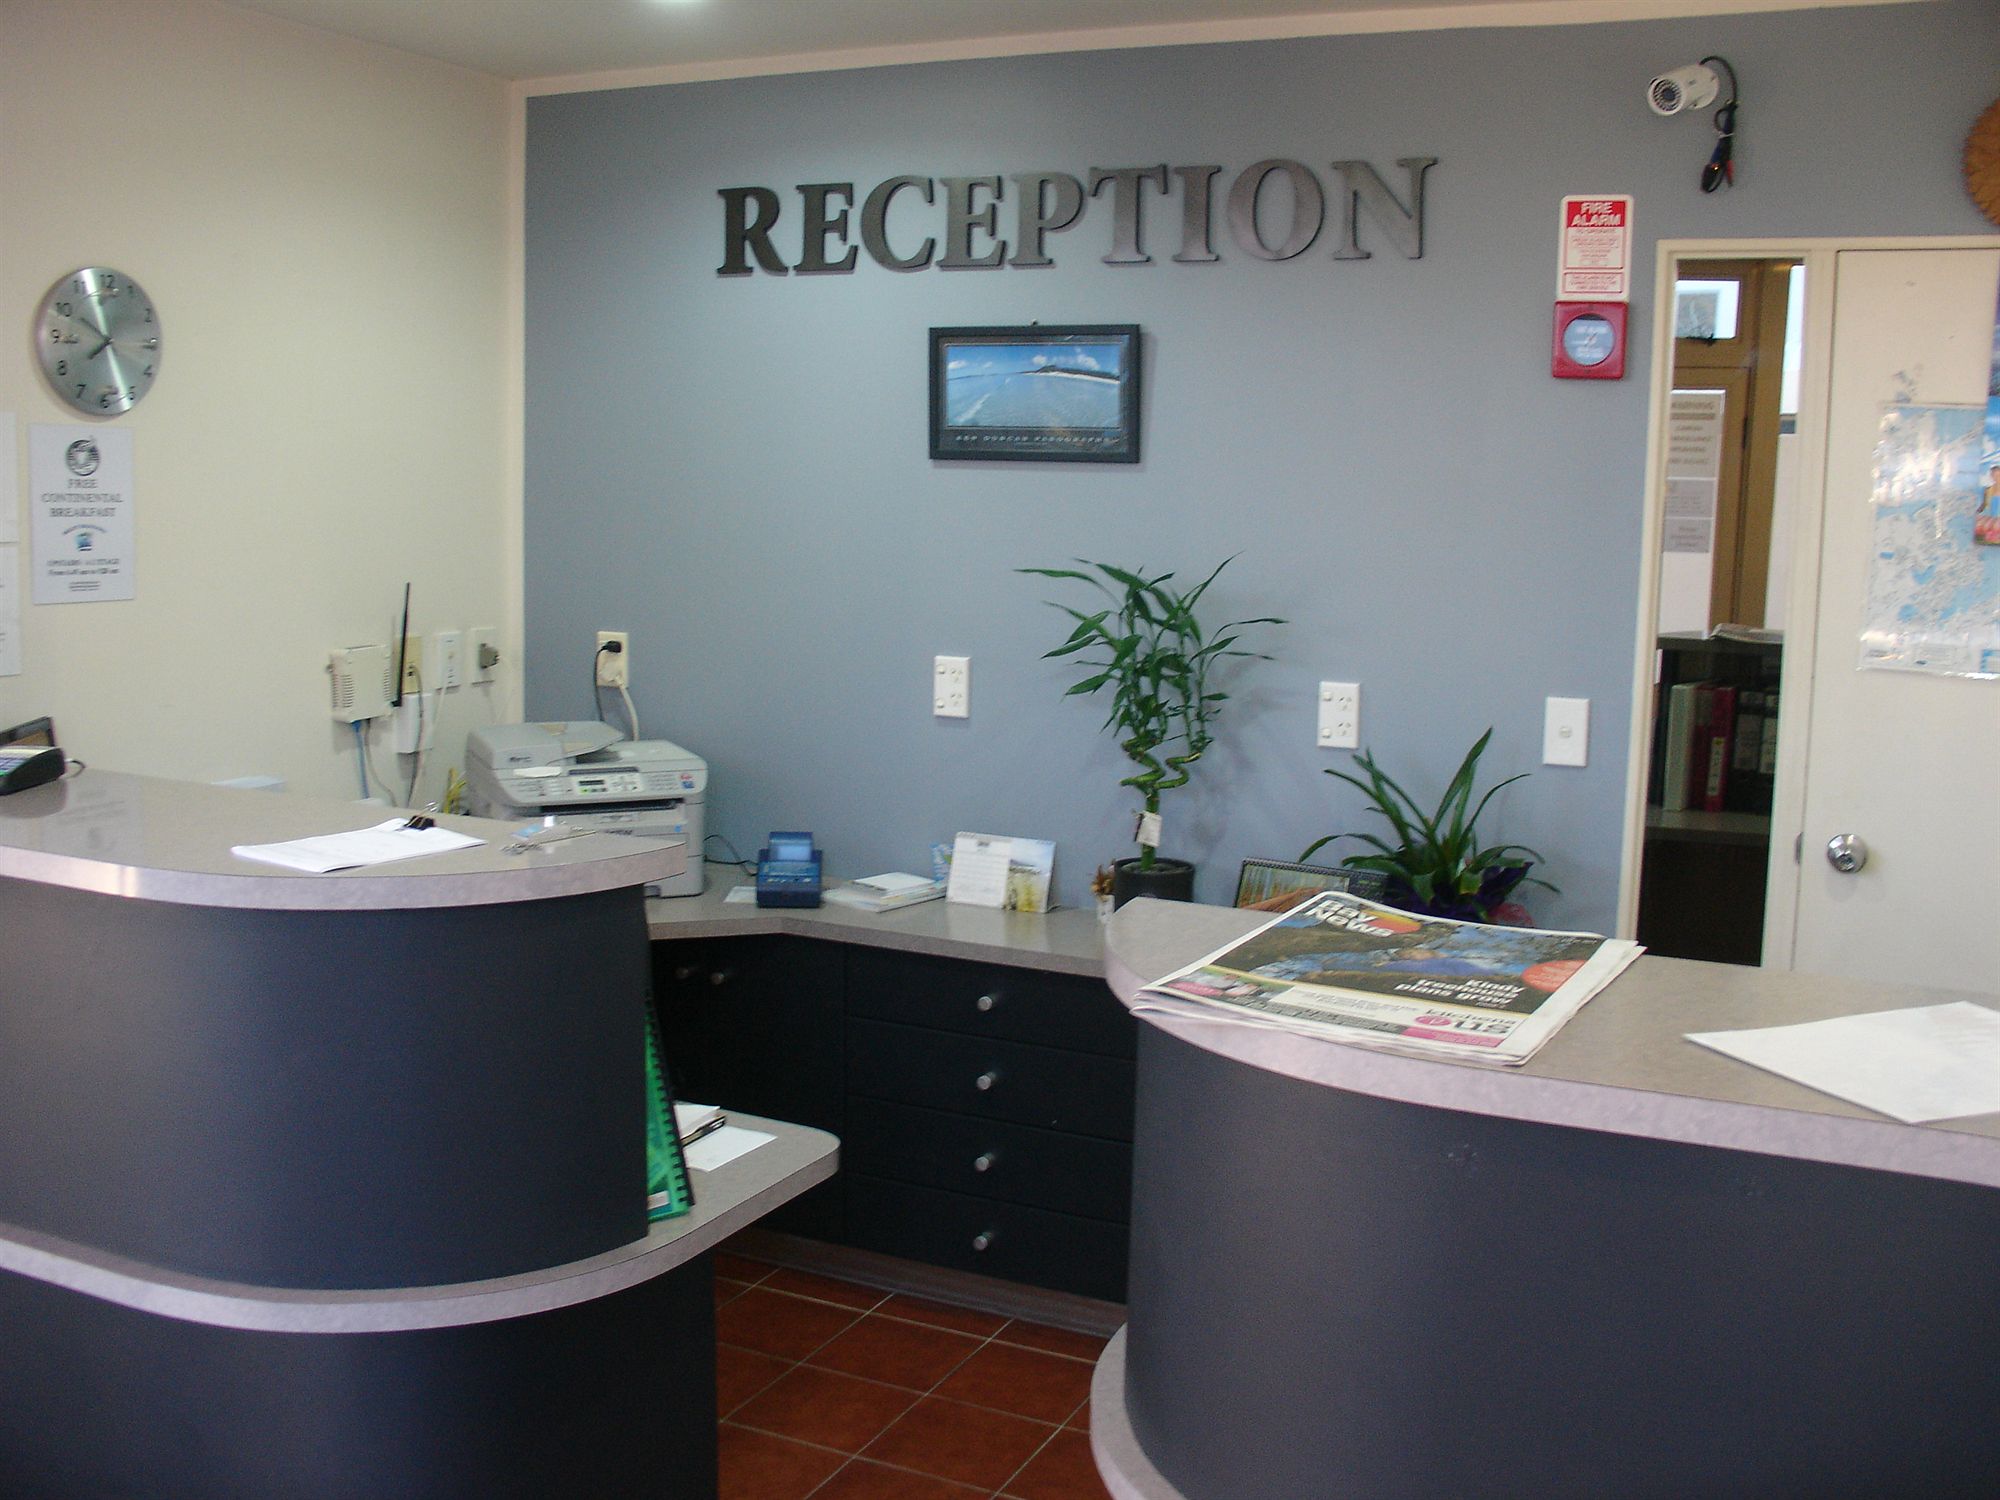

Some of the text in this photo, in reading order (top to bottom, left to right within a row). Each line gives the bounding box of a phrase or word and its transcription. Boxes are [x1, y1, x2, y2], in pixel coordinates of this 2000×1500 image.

[1581, 202, 1613, 214] FIRE
[716, 156, 1438, 277] RECEPTION
[1571, 214, 1621, 227] ALARM
[99, 274, 115, 289] 12
[56, 302, 73, 318] 10
[51, 329, 60, 344] 9
[57, 360, 67, 376] 8
[76, 384, 86, 399] 7
[100, 394, 110, 409] 6
[68, 479, 98, 489] FREE
[41, 494, 124, 503] CONTINENTAL
[50, 508, 116, 518] BREAKFAST
[1303, 899, 1379, 922] Bay
[1314, 909, 1395, 938] News
[1393, 983, 1513, 1004] plans grow
[1464, 979, 1527, 994] Kindy
[1424, 1007, 1517, 1026] kitchens
